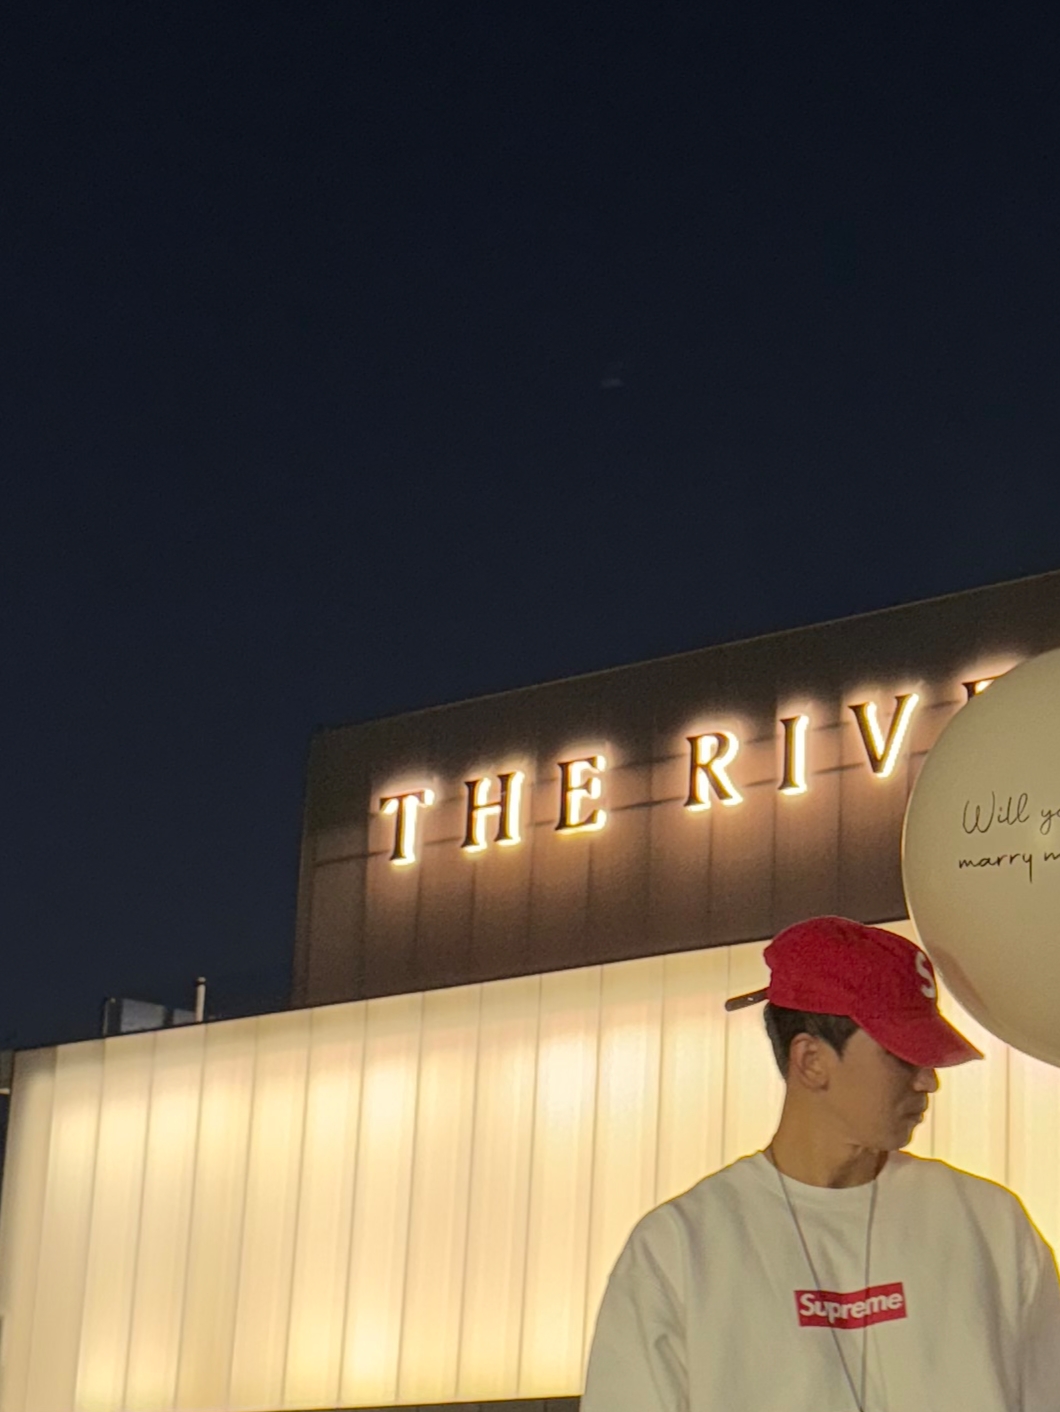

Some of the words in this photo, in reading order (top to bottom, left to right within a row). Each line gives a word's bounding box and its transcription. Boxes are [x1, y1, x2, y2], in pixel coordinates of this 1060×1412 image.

[379, 755, 607, 866] THE
[683, 675, 1002, 812] RIV
[962, 791, 1029, 834] Will
[958, 852, 1032, 884] marry
[799, 1292, 904, 1324] Supreme
